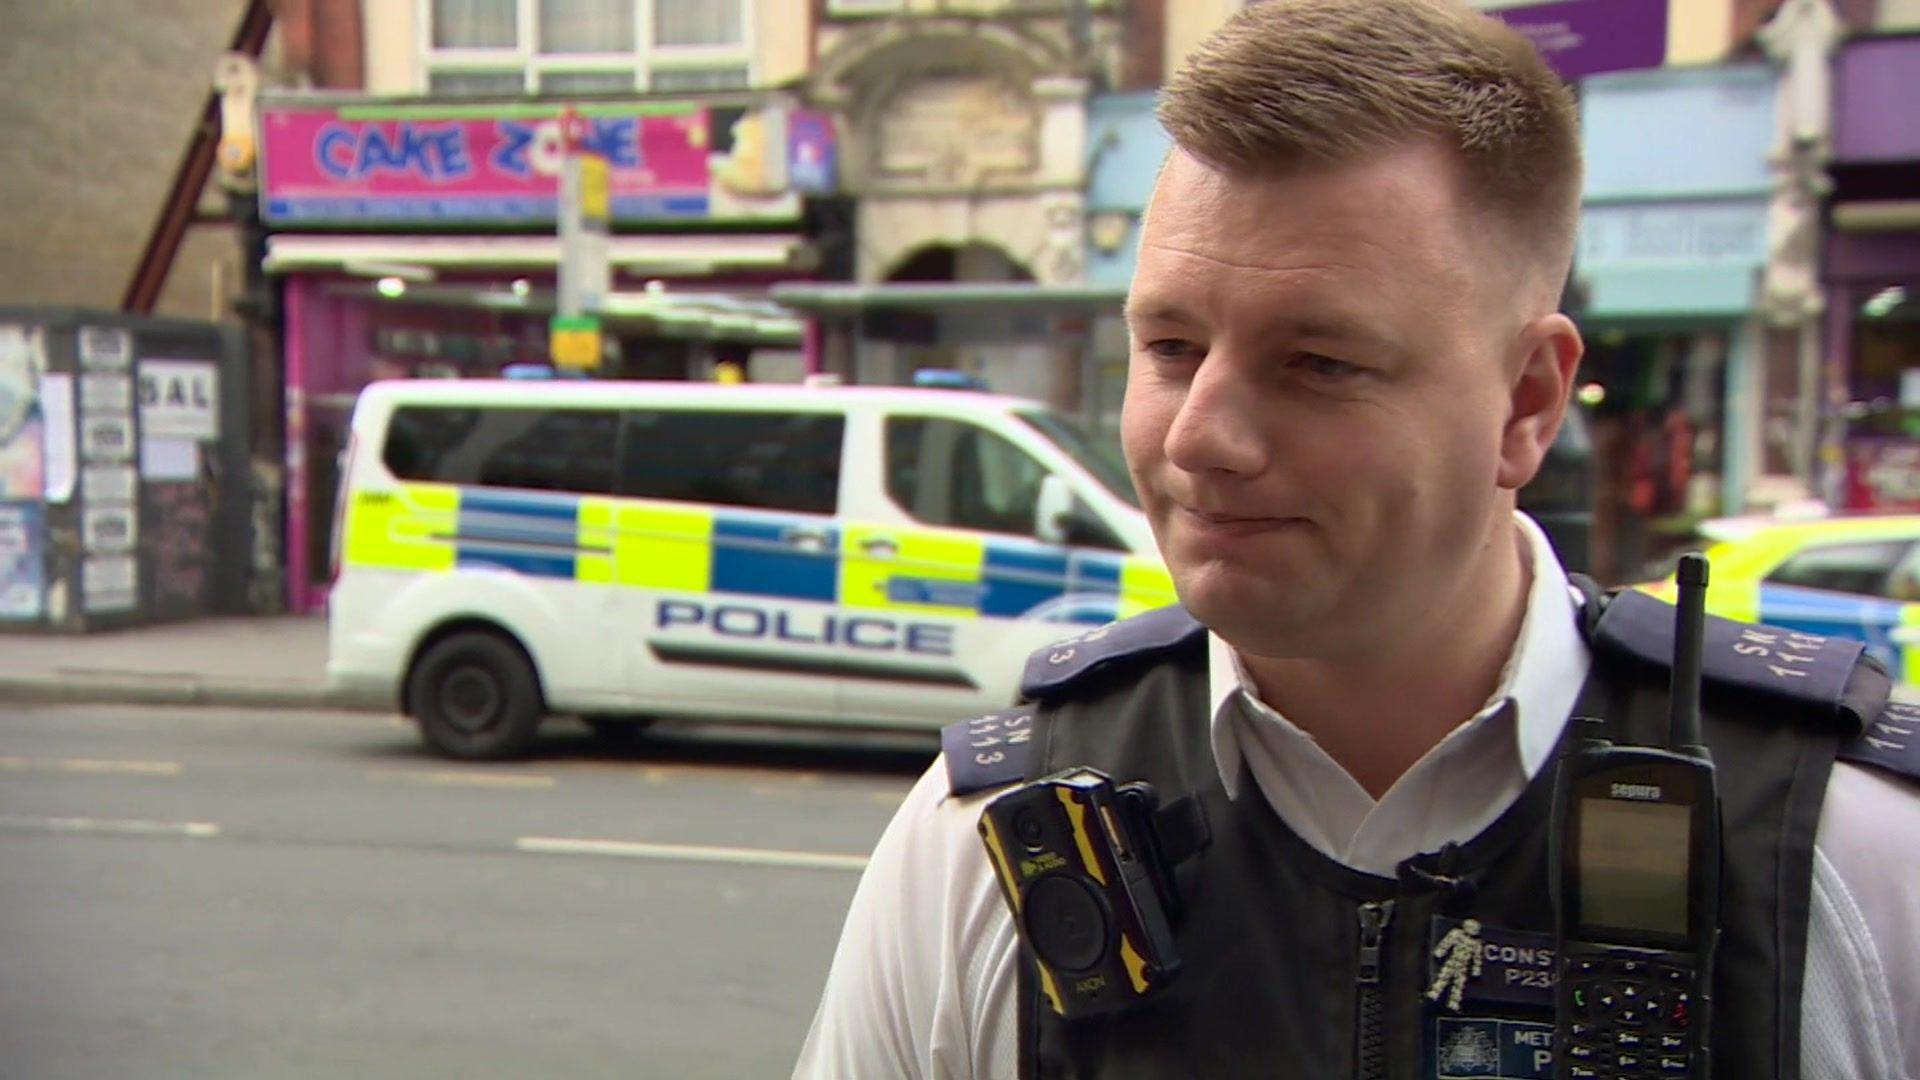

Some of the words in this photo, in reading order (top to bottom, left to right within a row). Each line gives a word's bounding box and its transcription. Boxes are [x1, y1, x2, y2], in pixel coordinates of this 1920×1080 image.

[315, 121, 470, 181] CAKE
[656, 599, 955, 657] POLICE
[1732, 628, 1778, 657] SN
[968, 714, 1006, 766] 1113
[1003, 714, 1032, 744] SN
[1610, 782, 1662, 801] sepura
[1484, 944, 1556, 967] CONS
